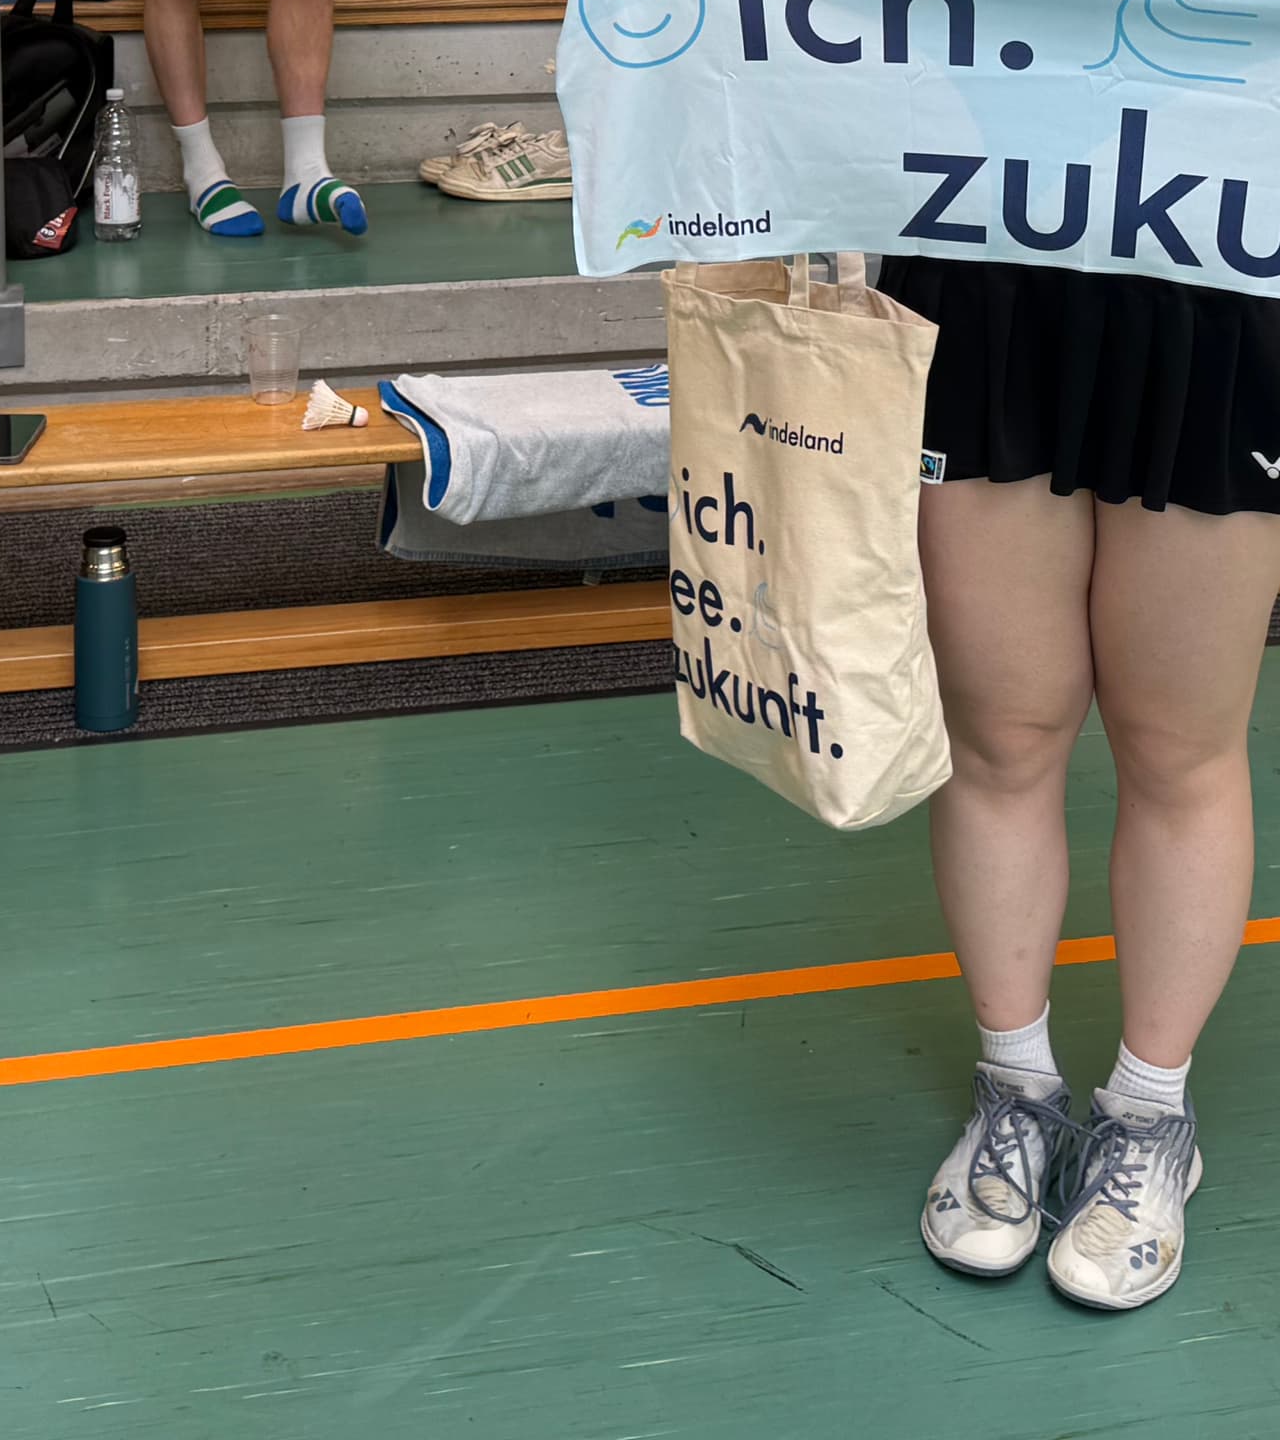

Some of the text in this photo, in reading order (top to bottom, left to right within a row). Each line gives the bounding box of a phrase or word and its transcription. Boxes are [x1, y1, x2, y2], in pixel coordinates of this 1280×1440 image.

[667, 209, 771, 237] indeland
[768, 418, 844, 454] indeland
[681, 467, 765, 555] ich.
[670, 569, 742, 633] ee.
